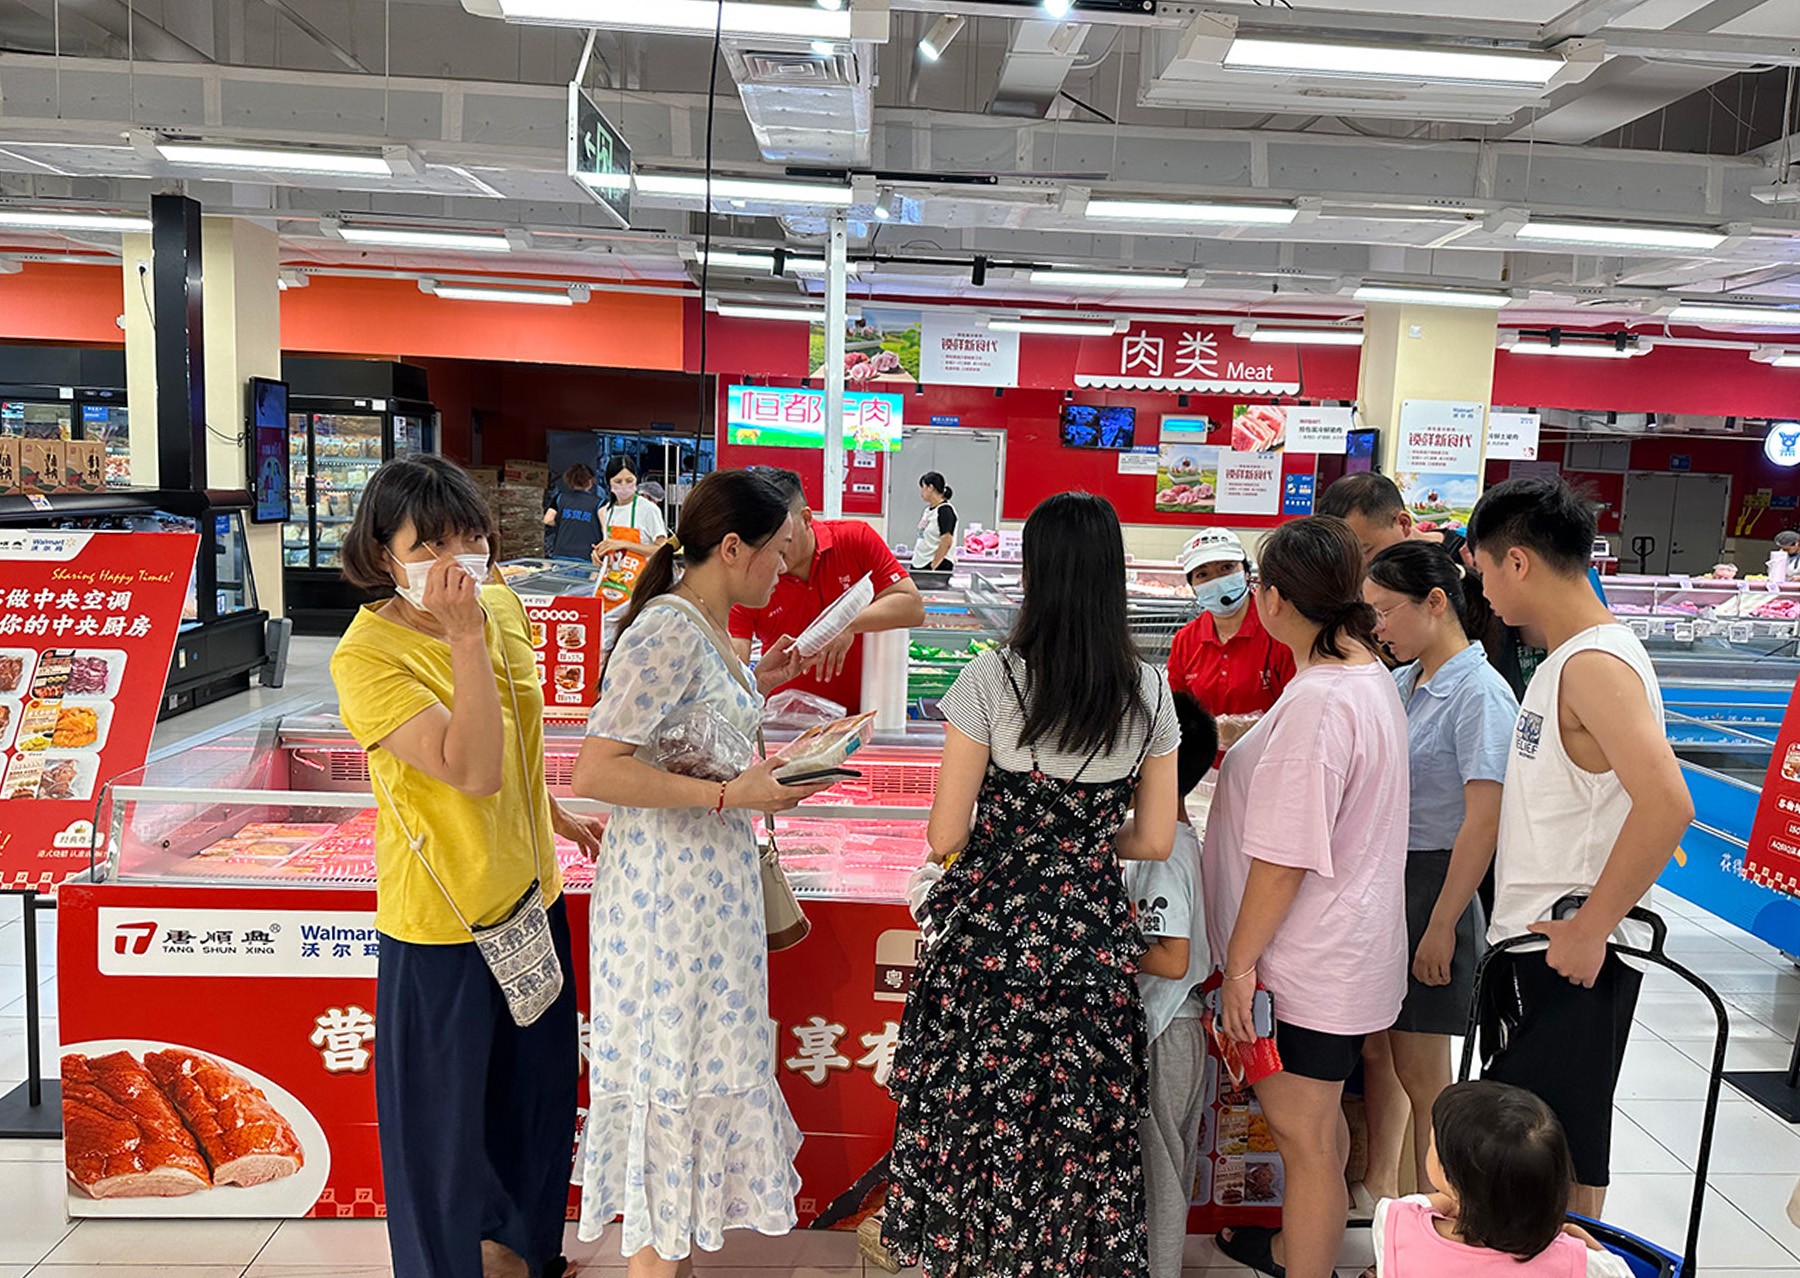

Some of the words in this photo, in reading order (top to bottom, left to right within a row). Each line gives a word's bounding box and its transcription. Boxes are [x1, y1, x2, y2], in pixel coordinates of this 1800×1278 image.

[1120, 329, 1219, 378] 肉类
[1226, 361, 1274, 380] Meat
[51, 568, 96, 584] Sharing
[99, 570, 134, 584] Happy
[137, 569, 174, 583] Times!
[162, 946, 194, 954] TANG
[202, 946, 237, 954] SHUN
[245, 946, 275, 954] XING
[309, 1004, 377, 1073] 营
[770, 1014, 899, 1086] 享有
